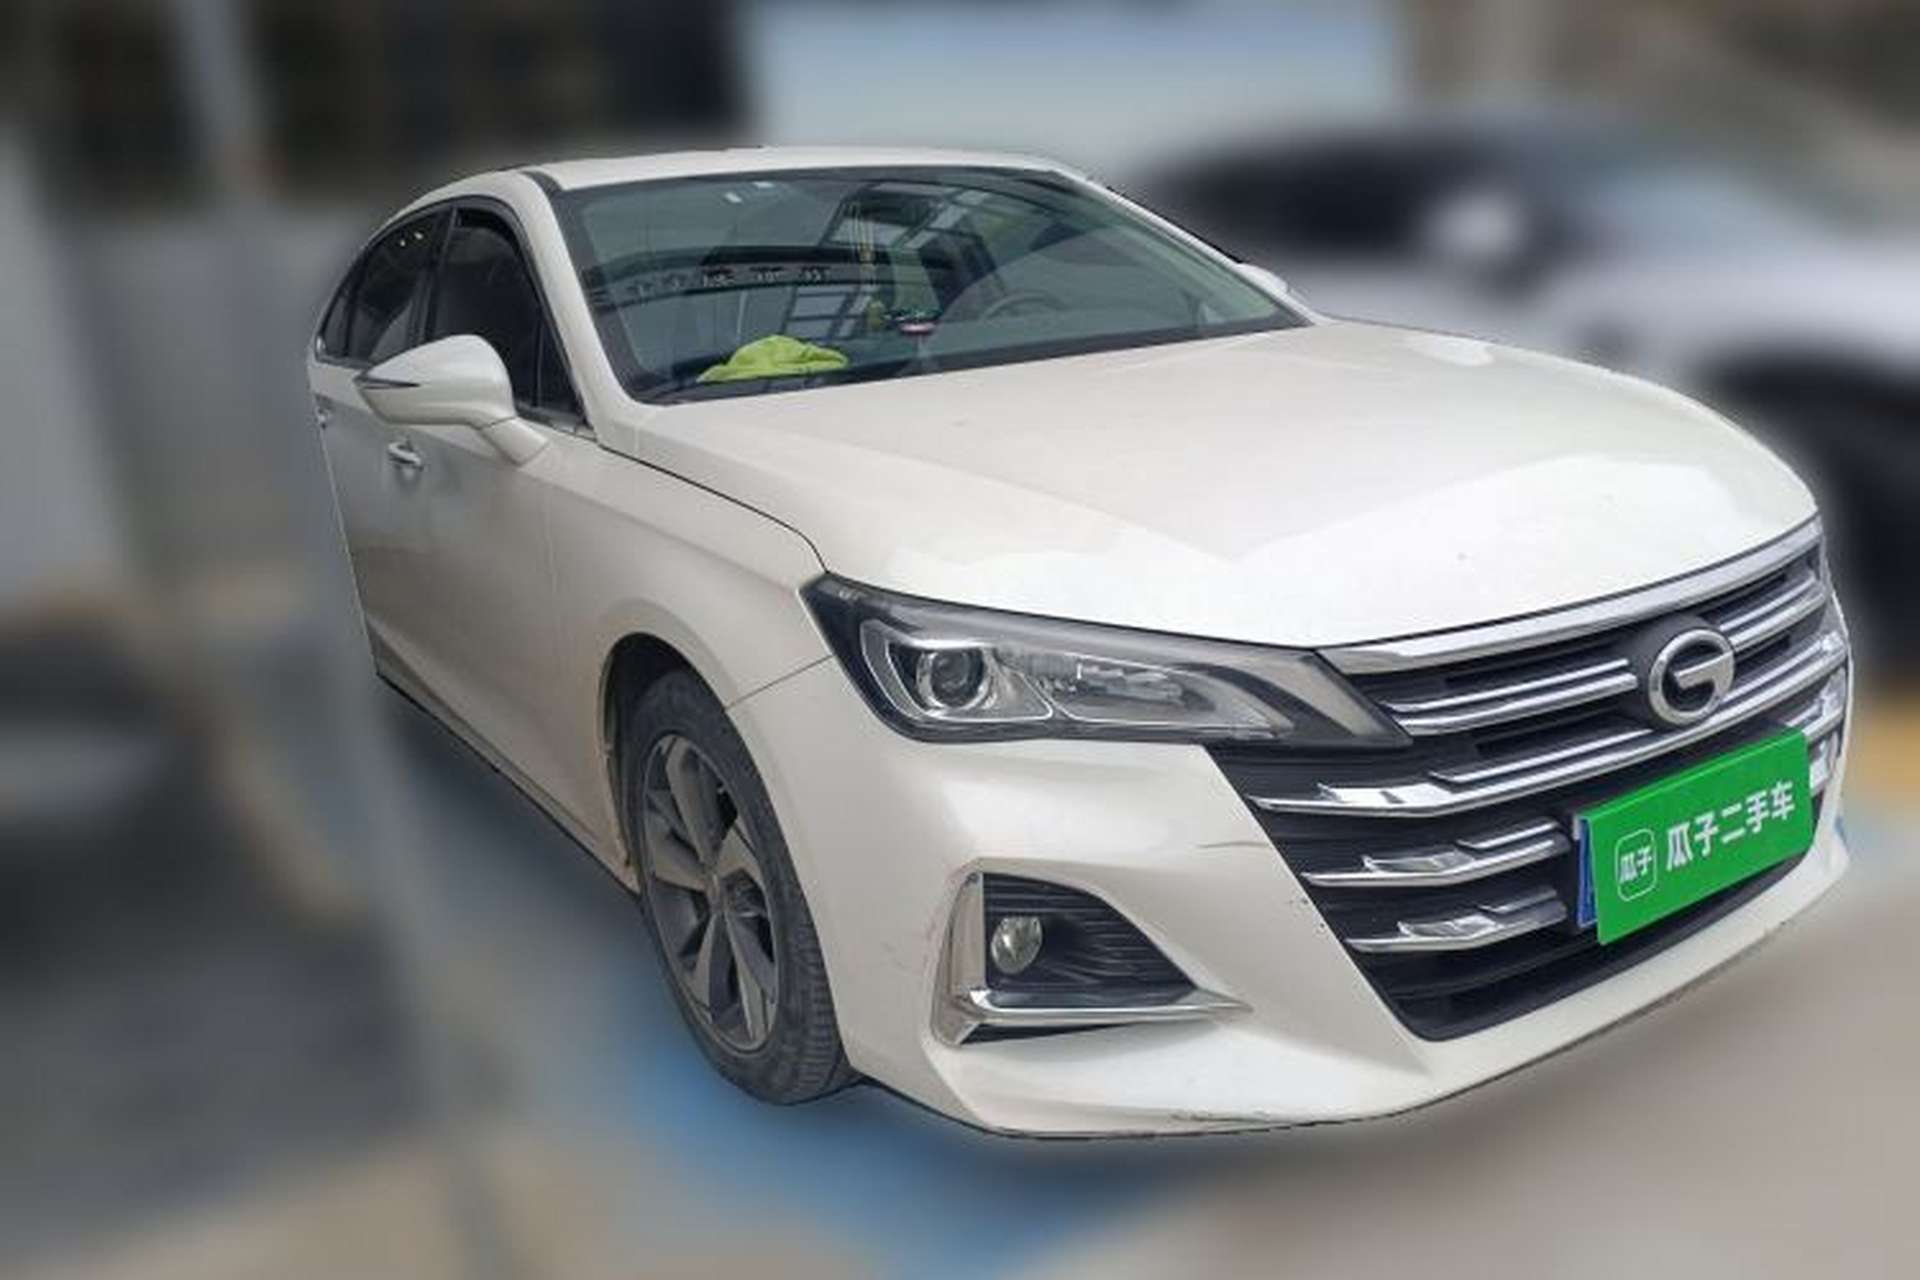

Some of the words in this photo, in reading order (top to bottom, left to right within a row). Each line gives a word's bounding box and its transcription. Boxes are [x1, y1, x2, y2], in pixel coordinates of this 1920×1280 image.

[1666, 780, 1796, 871] 瓜子二手车
[1619, 847, 1652, 884] 瓜子
